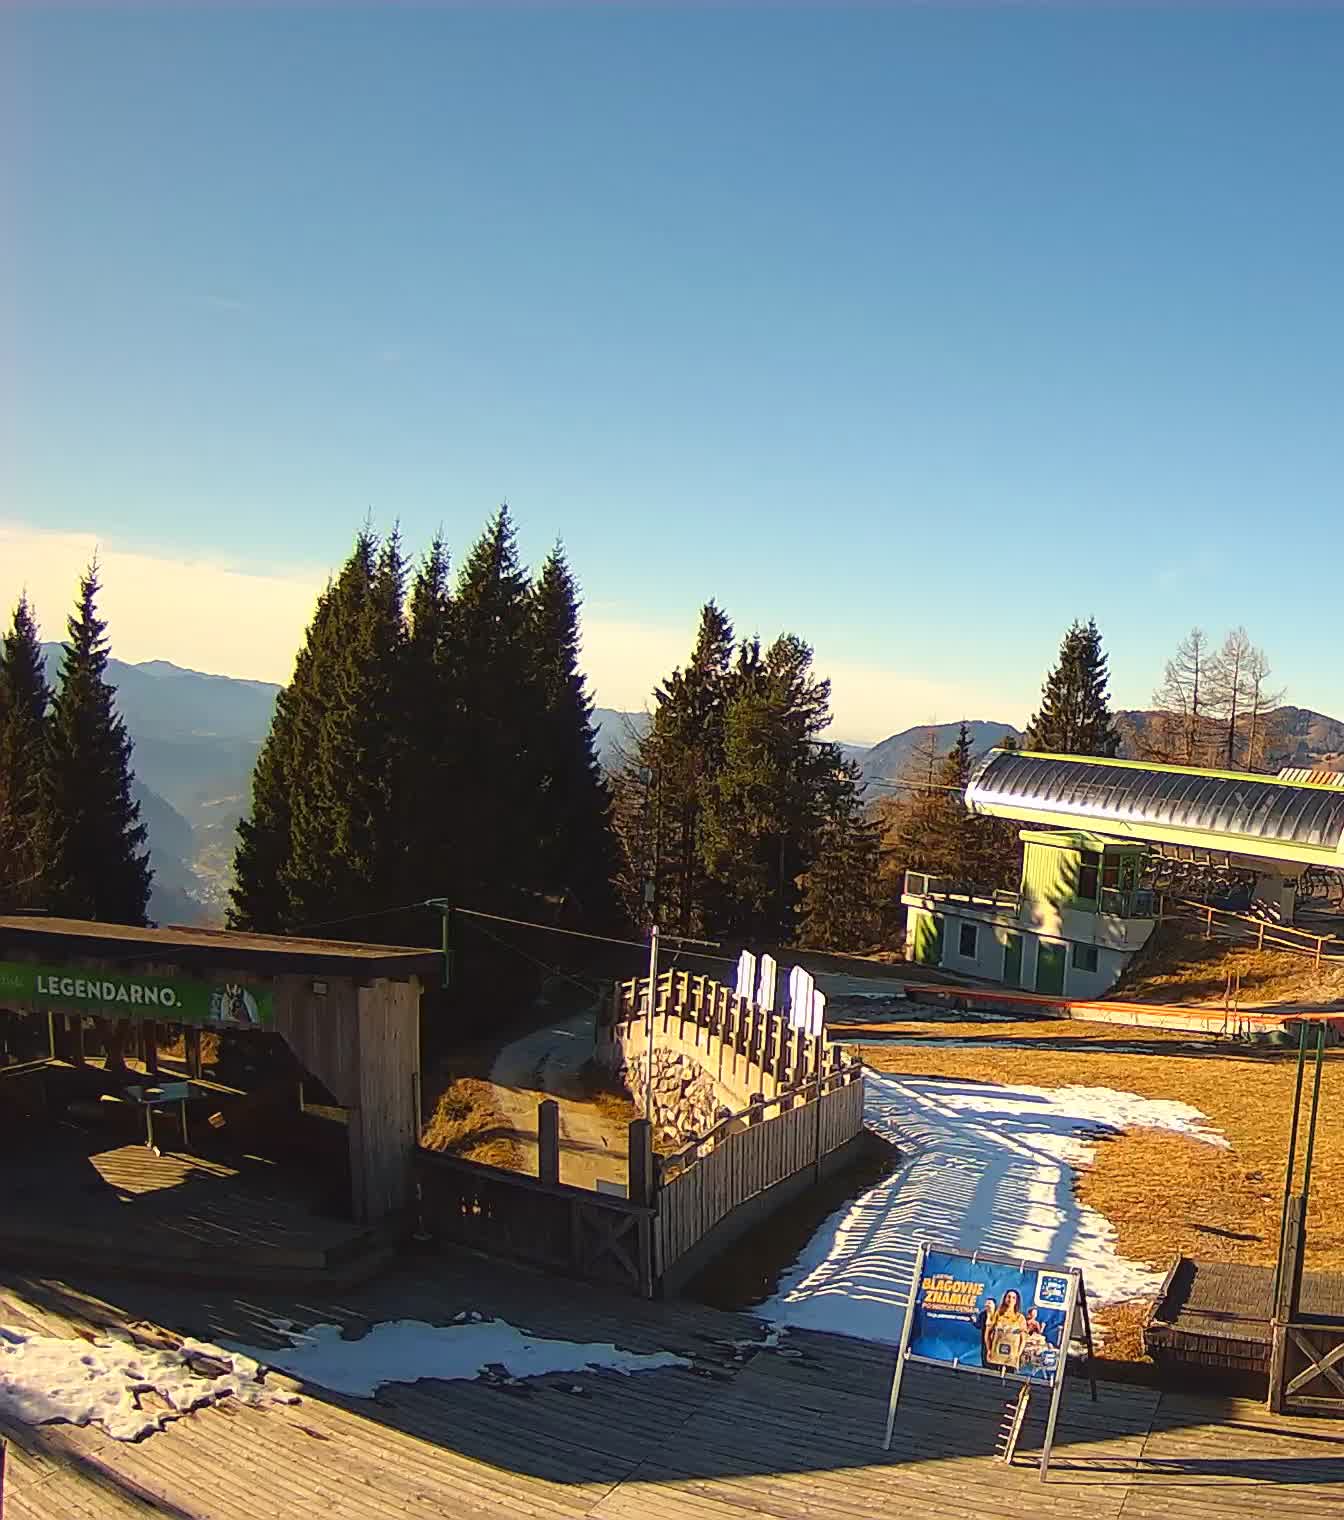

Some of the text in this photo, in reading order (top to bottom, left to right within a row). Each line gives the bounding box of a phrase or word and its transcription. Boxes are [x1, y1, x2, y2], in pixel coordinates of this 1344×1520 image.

[37, 975, 183, 1008] LEGENDARNO.
[922, 1277, 985, 1296] BLAGOVNE
[924, 1290, 977, 1307] ZNAMKE
